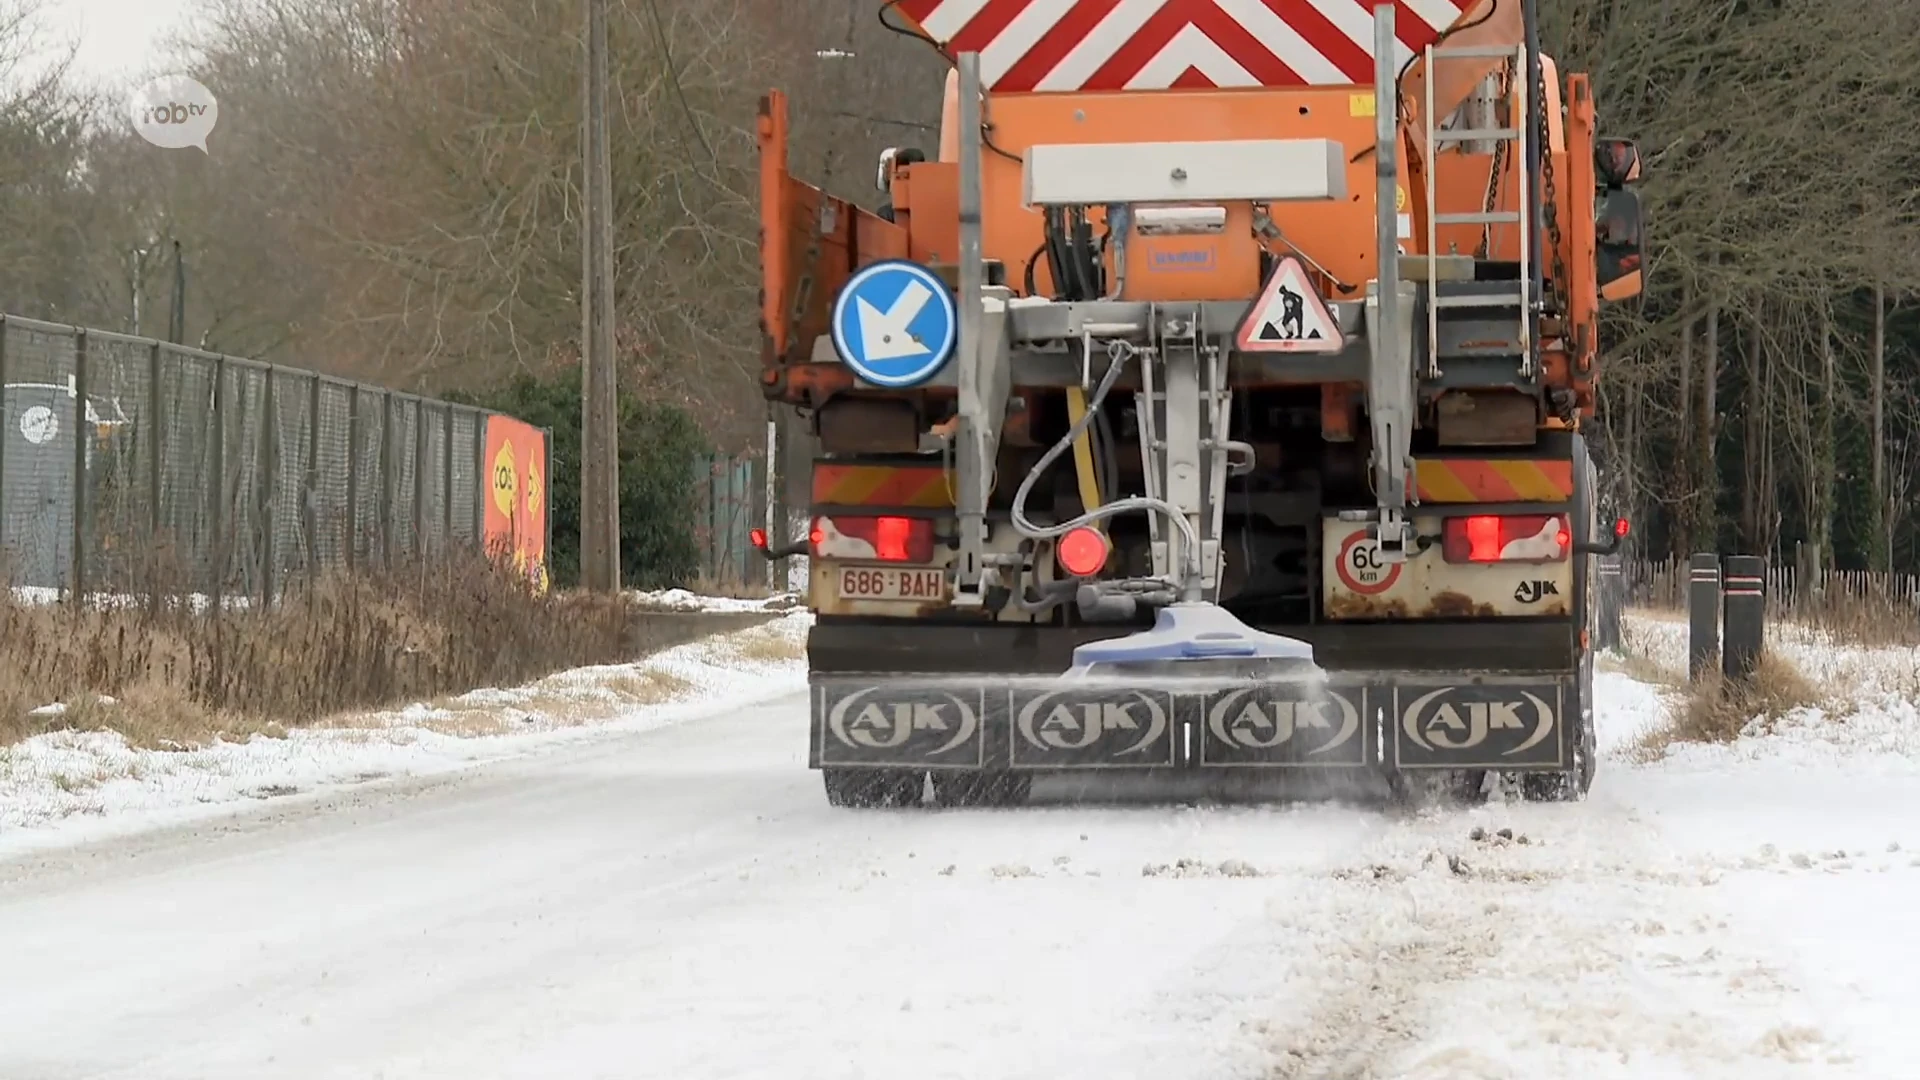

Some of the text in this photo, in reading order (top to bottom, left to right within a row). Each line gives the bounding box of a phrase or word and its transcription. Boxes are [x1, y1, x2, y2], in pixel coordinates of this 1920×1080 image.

[1359, 570, 1378, 581] km
[1514, 580, 1559, 604] AJK
[850, 702, 949, 748] AJK
[1040, 702, 1139, 749] AJK
[1231, 701, 1331, 748] AJK
[1425, 702, 1525, 749] AJK
